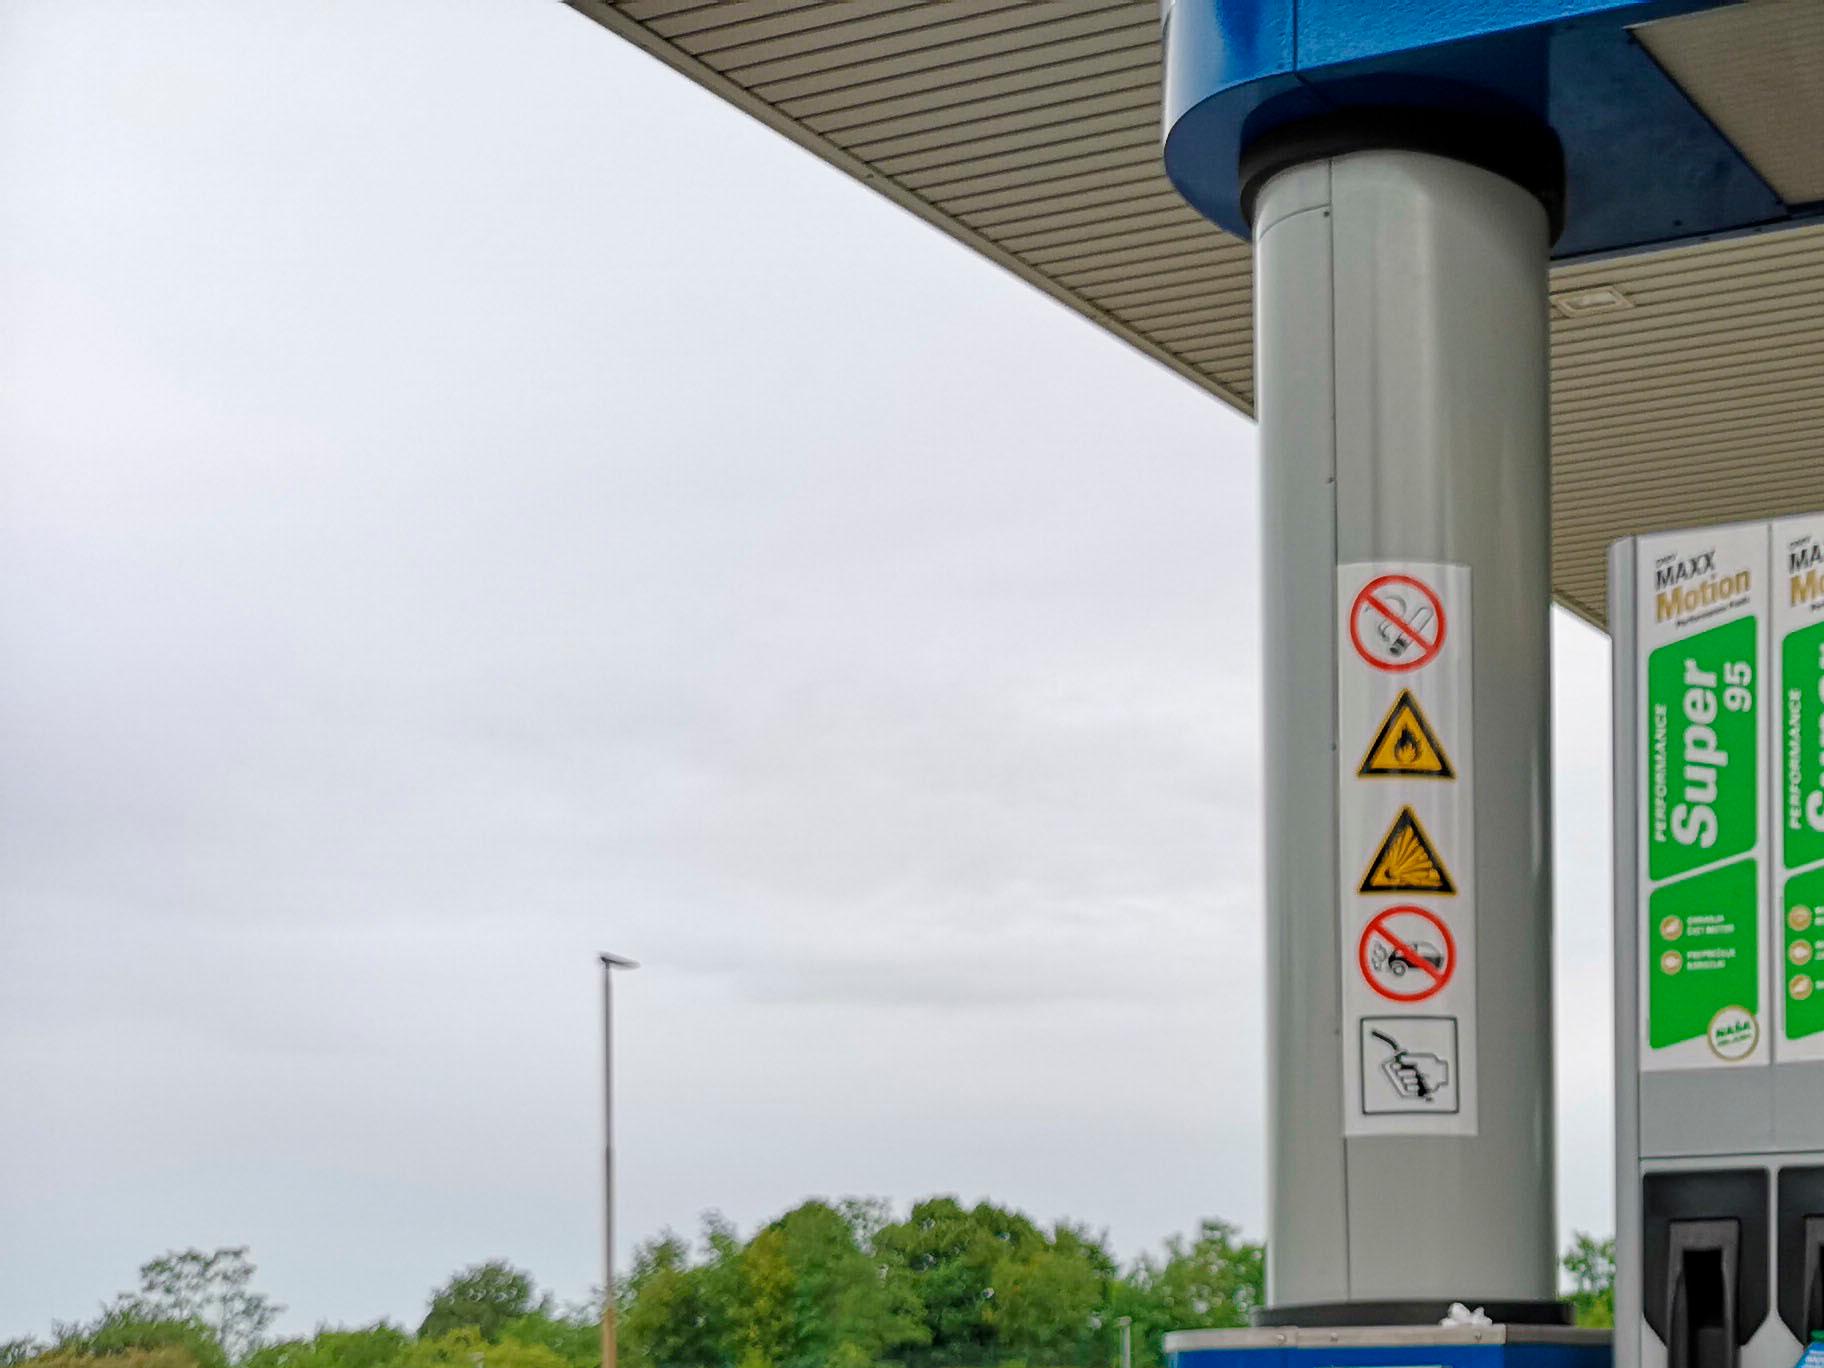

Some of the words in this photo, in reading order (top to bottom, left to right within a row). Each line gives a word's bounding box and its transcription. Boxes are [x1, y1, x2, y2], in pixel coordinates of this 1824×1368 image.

[1656, 551, 1715, 591] MAXX
[1656, 570, 1751, 623] Motion
[1723, 661, 1752, 712] 95
[1654, 704, 1667, 842] PERFORMANCE
[1671, 658, 1728, 848] Super
[1789, 688, 1802, 829] PERFORMANCE
